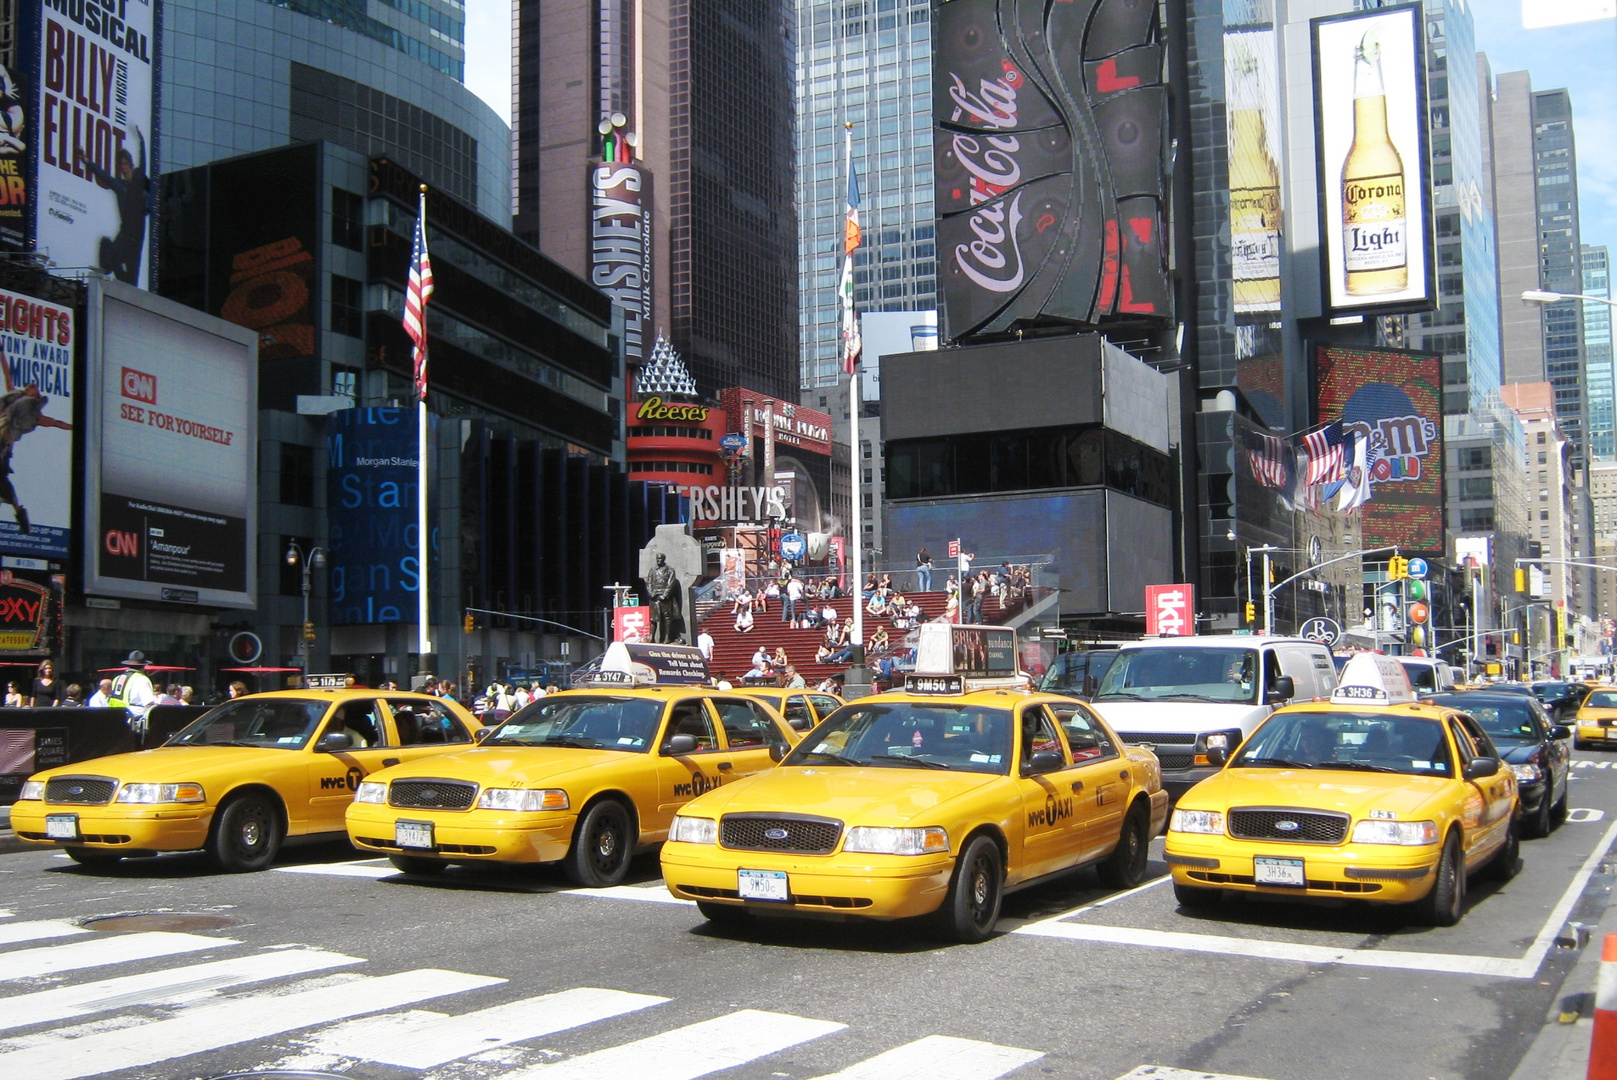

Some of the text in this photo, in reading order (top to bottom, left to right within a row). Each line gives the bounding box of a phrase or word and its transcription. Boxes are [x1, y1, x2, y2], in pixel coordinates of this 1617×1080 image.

[45, 17, 116, 119] BILLY
[114, 58, 128, 126] THE MUSICAL
[43, 91, 127, 190] ELLIOT
[1346, 184, 1402, 205] Corona
[1351, 227, 1400, 252] Light
[642, 210, 651, 321] Milk Chocolate
[33, 342, 70, 366] AWARD
[10, 355, 70, 398] MUSICAL
[124, 372, 154, 400] CNN
[637, 396, 709, 422] Reese's
[121, 403, 233, 446] SEE FOR YOURSELF
[356, 456, 390, 468] Morgan
[105, 530, 139, 558] CNN
[954, 630, 981, 646] BRICK
[988, 635, 1012, 648] sundance
[602, 671, 621, 681] 3Y47
[682, 670, 706, 678] Checking.
[916, 678, 946, 691] 9M50
[1348, 687, 1372, 697] 3H36
[321, 777, 346, 789] NYC
[673, 783, 692, 797] NYC
[1028, 794, 1073, 828] NYC TAXI
[1369, 810, 1397, 818] 831
